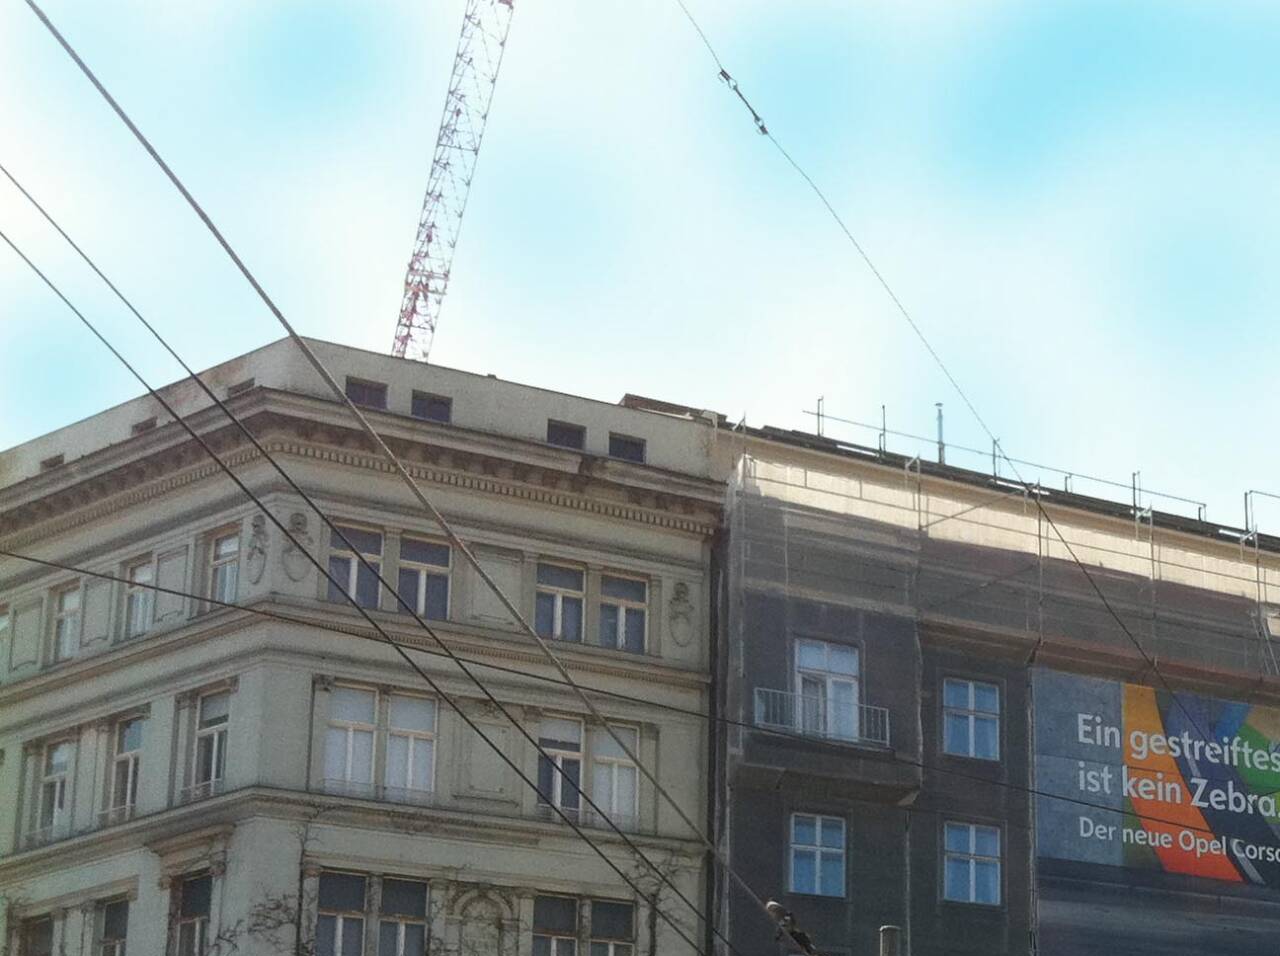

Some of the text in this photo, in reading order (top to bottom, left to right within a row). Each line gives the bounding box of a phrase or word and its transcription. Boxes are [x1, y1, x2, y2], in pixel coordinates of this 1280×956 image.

[1077, 713, 1121, 748] Ein
[1079, 761, 1113, 794] ist
[1123, 766, 1182, 804] kein
[1079, 817, 1116, 841] Der
[1123, 828, 1173, 849] neue
[1178, 830, 1227, 857] Opel
